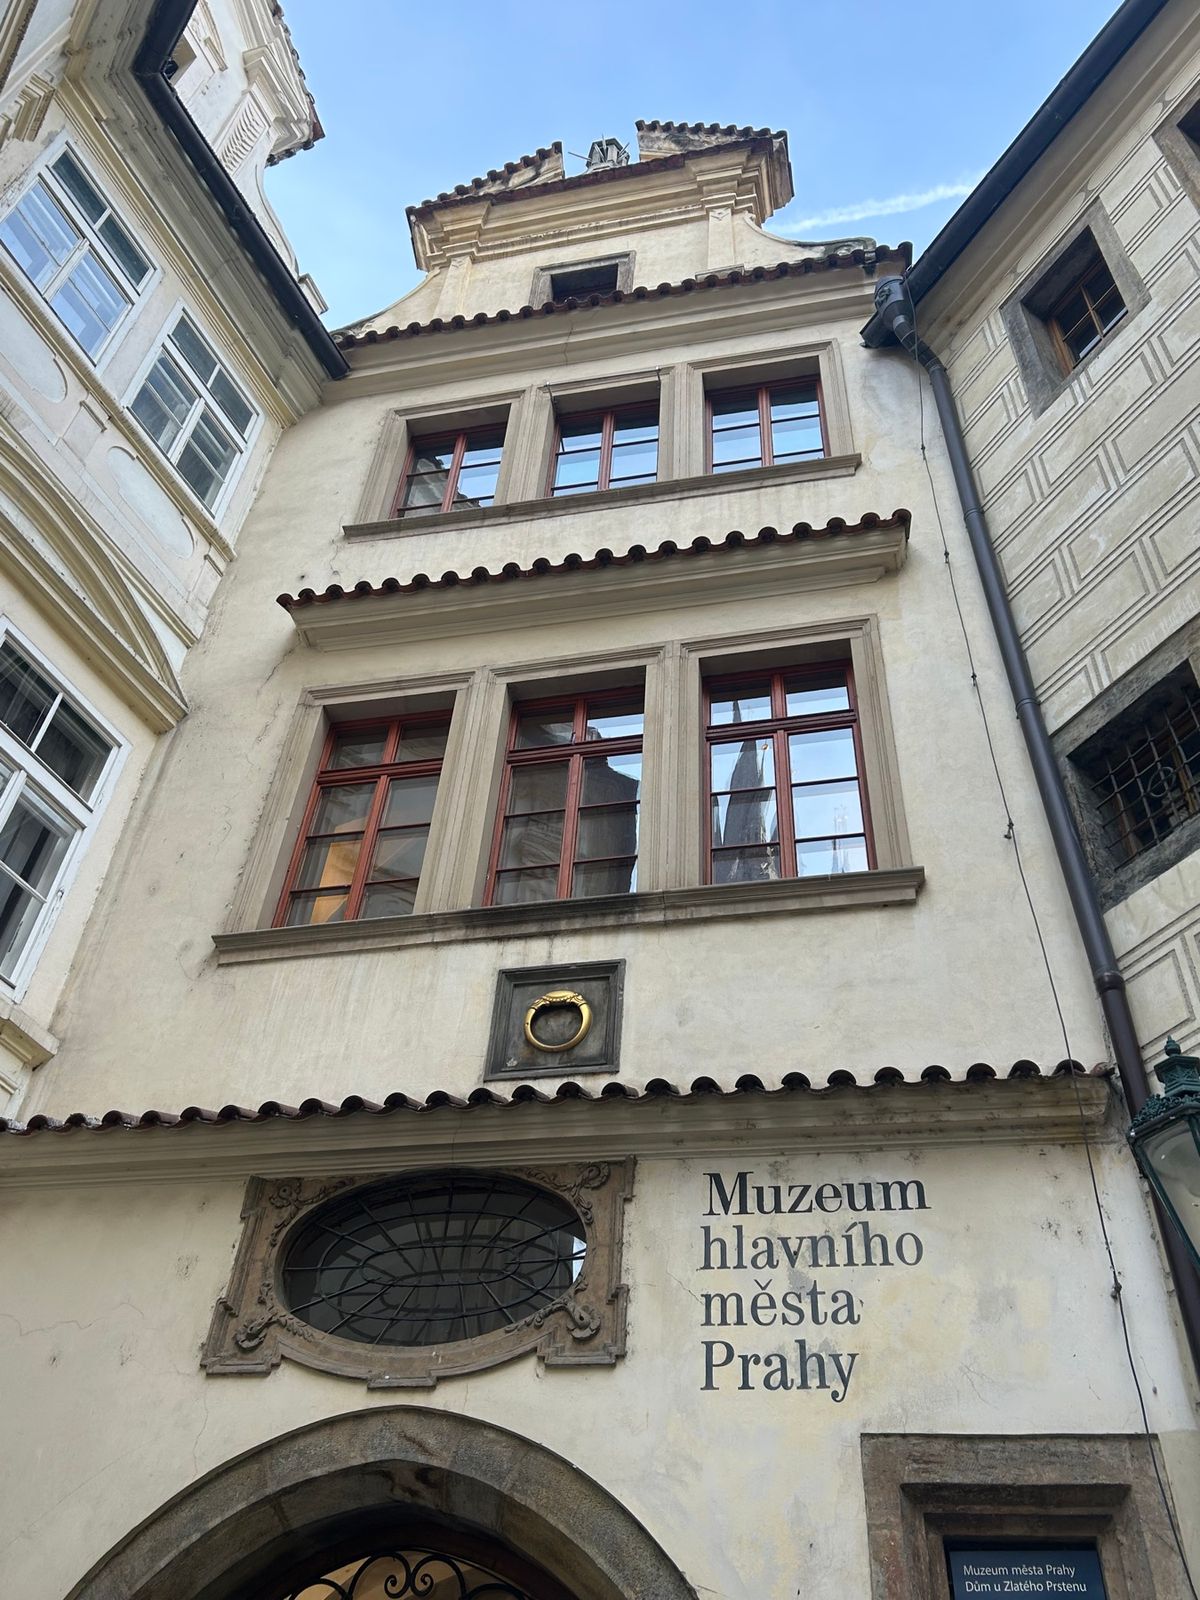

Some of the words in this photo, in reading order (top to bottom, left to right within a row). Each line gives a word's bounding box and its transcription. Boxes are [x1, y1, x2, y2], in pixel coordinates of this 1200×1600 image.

[702, 1171, 931, 1216] Muzeum
[700, 1221, 924, 1270] hlavního
[700, 1279, 861, 1326] města
[700, 1339, 859, 1403] Prahy
[963, 1565, 1009, 1576] Muzeum
[1012, 1564, 1044, 1576] města
[1046, 1564, 1075, 1578] Prahy
[965, 1581, 991, 1592] Dům
[994, 1583, 1001, 1592] u
[1003, 1580, 1043, 1592] Zlatého
[1046, 1581, 1087, 1592] Prstenu
